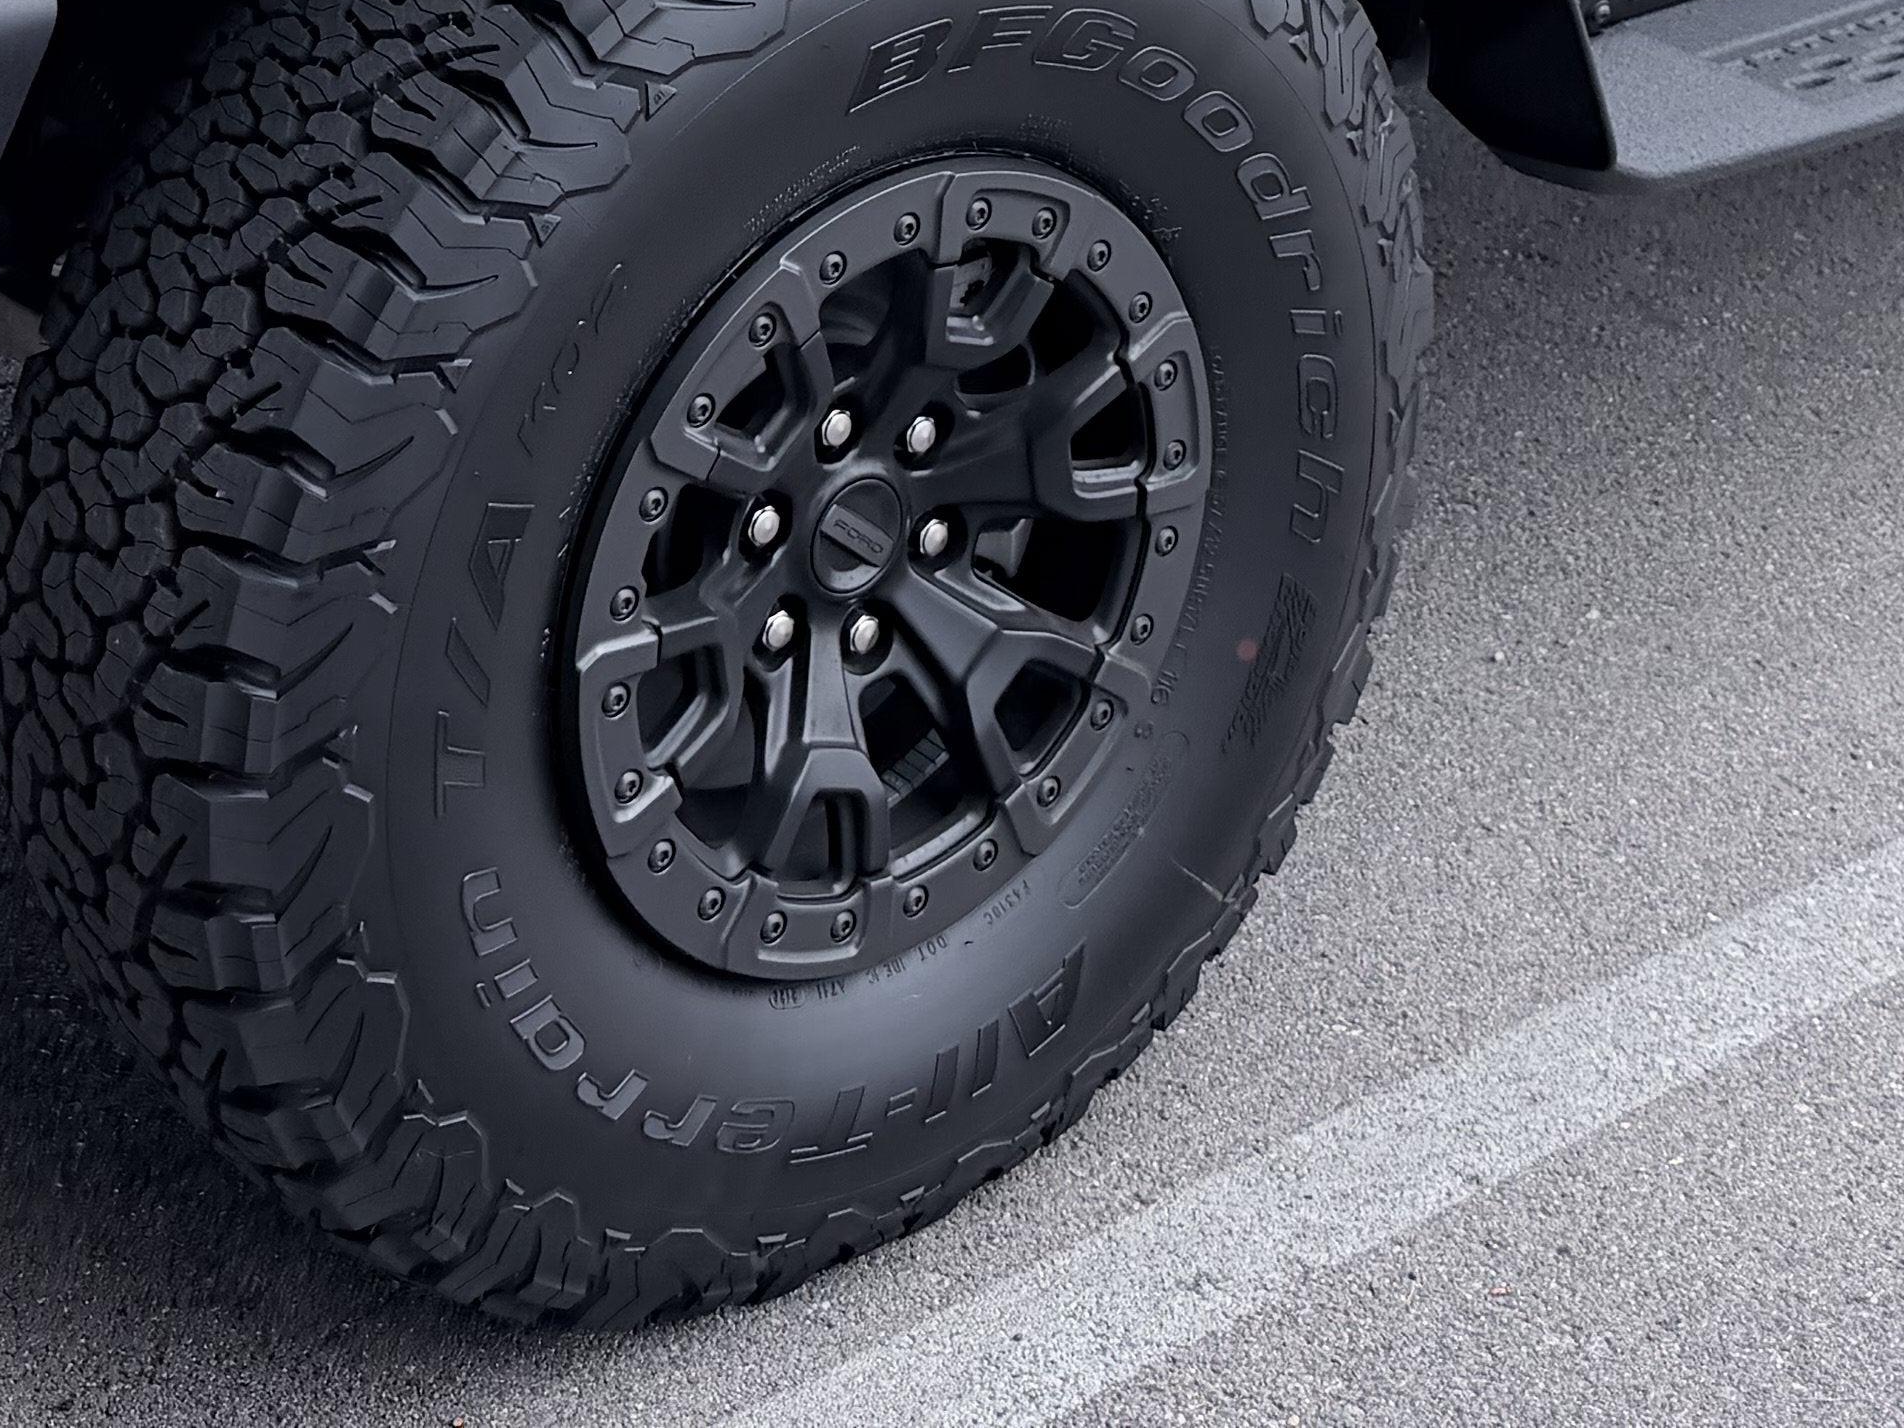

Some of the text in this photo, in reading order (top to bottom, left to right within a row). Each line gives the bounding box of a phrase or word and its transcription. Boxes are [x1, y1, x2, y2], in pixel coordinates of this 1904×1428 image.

[846, 5, 1345, 544] BFGoodrich
[834, 519, 884, 554] FORD
[460, 867, 1086, 1163] All-Terrain
